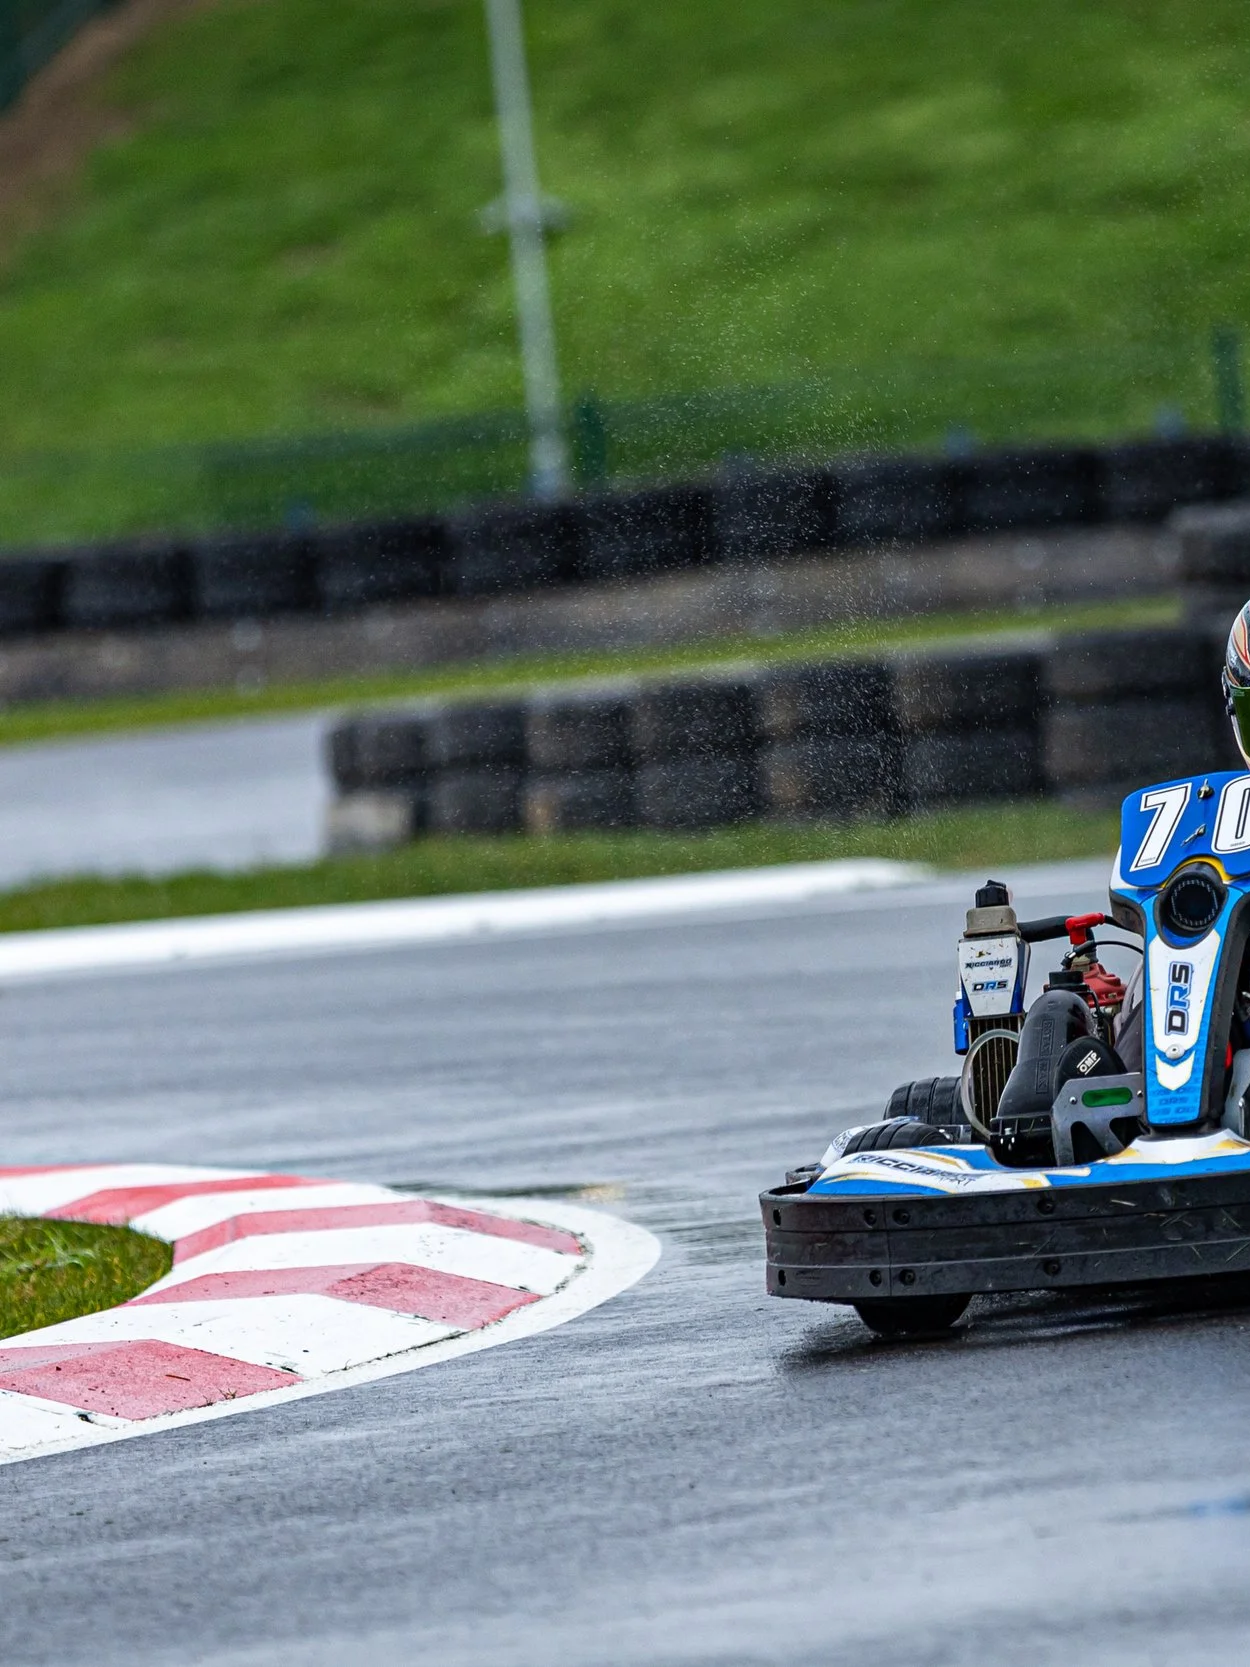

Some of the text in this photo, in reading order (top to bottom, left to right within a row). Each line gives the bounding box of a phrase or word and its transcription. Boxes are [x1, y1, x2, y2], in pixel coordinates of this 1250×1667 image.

[973, 980, 1008, 992] DRS
[1165, 961, 1193, 1036] DRS
[1079, 1052, 1098, 1073] OMP
